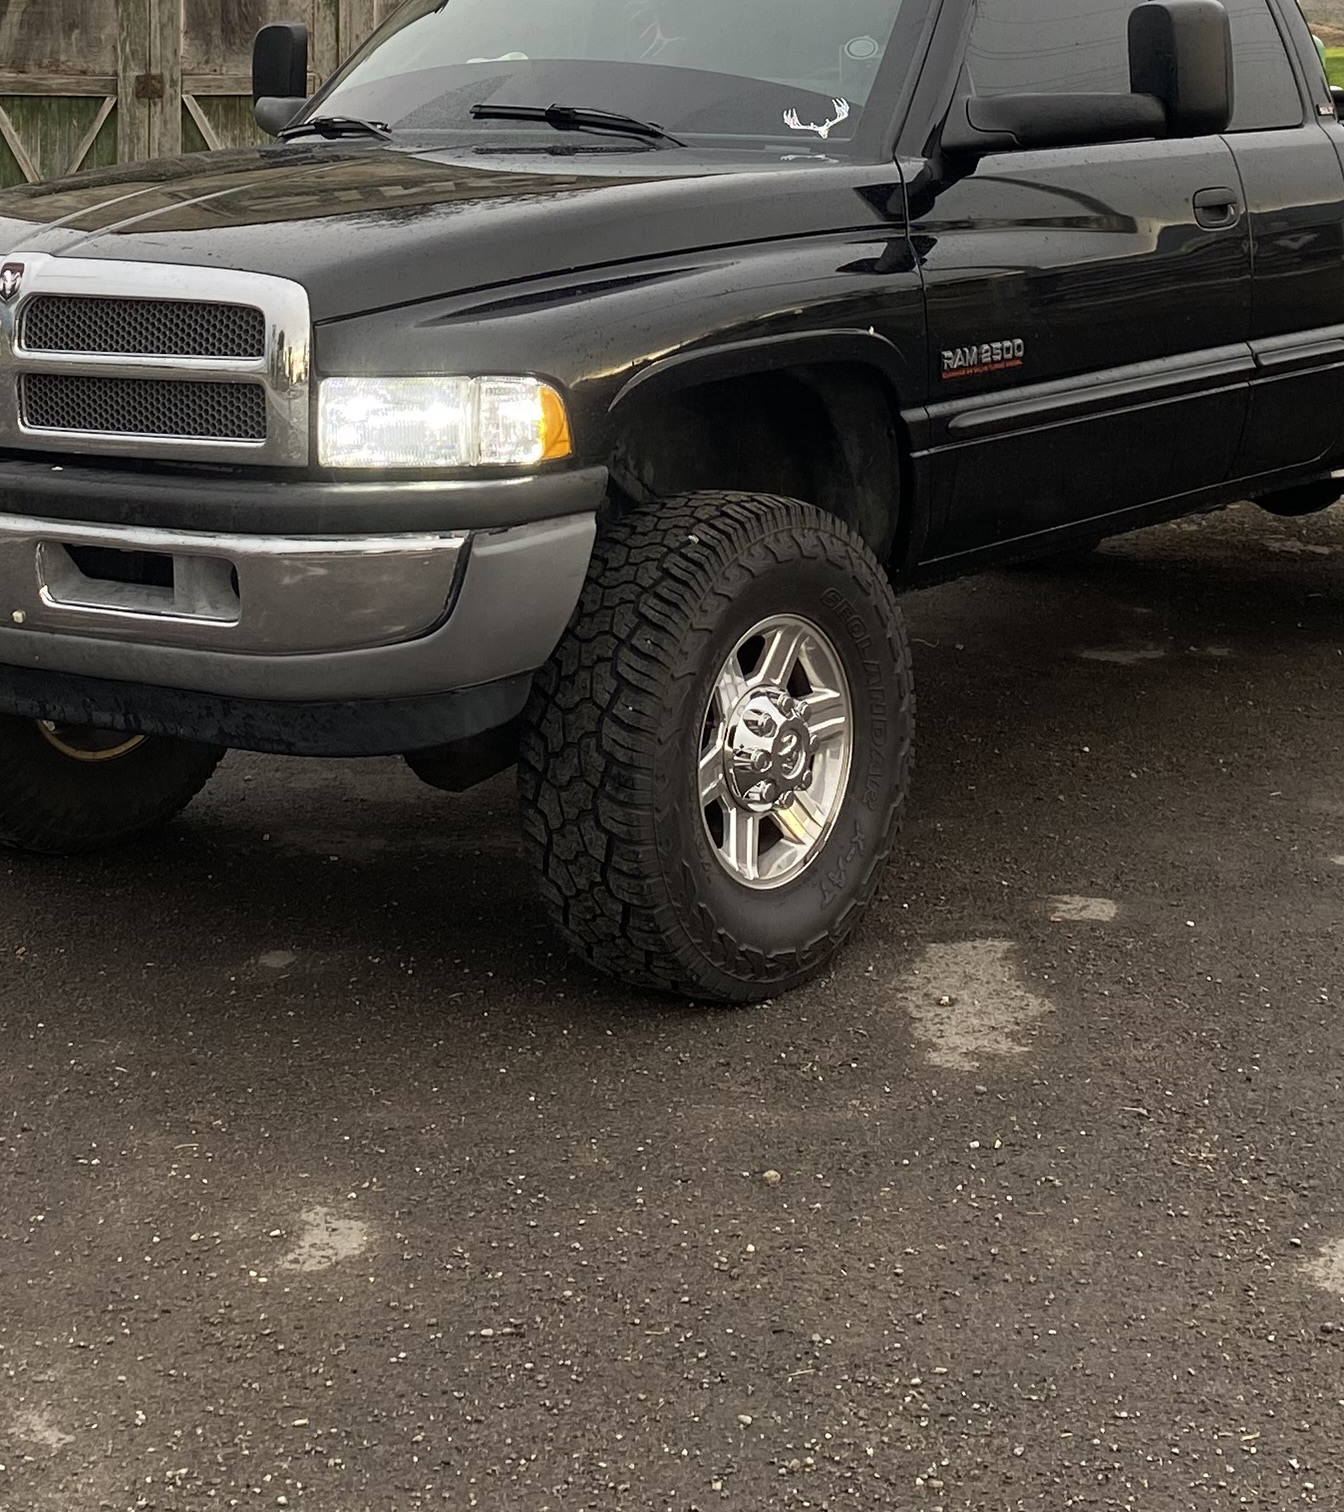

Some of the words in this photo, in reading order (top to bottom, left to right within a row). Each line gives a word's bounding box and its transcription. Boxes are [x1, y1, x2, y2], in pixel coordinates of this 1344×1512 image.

[941, 345, 977, 370] RAM
[979, 338, 1025, 364] 2500
[819, 586, 888, 812] GEOLANDAR
